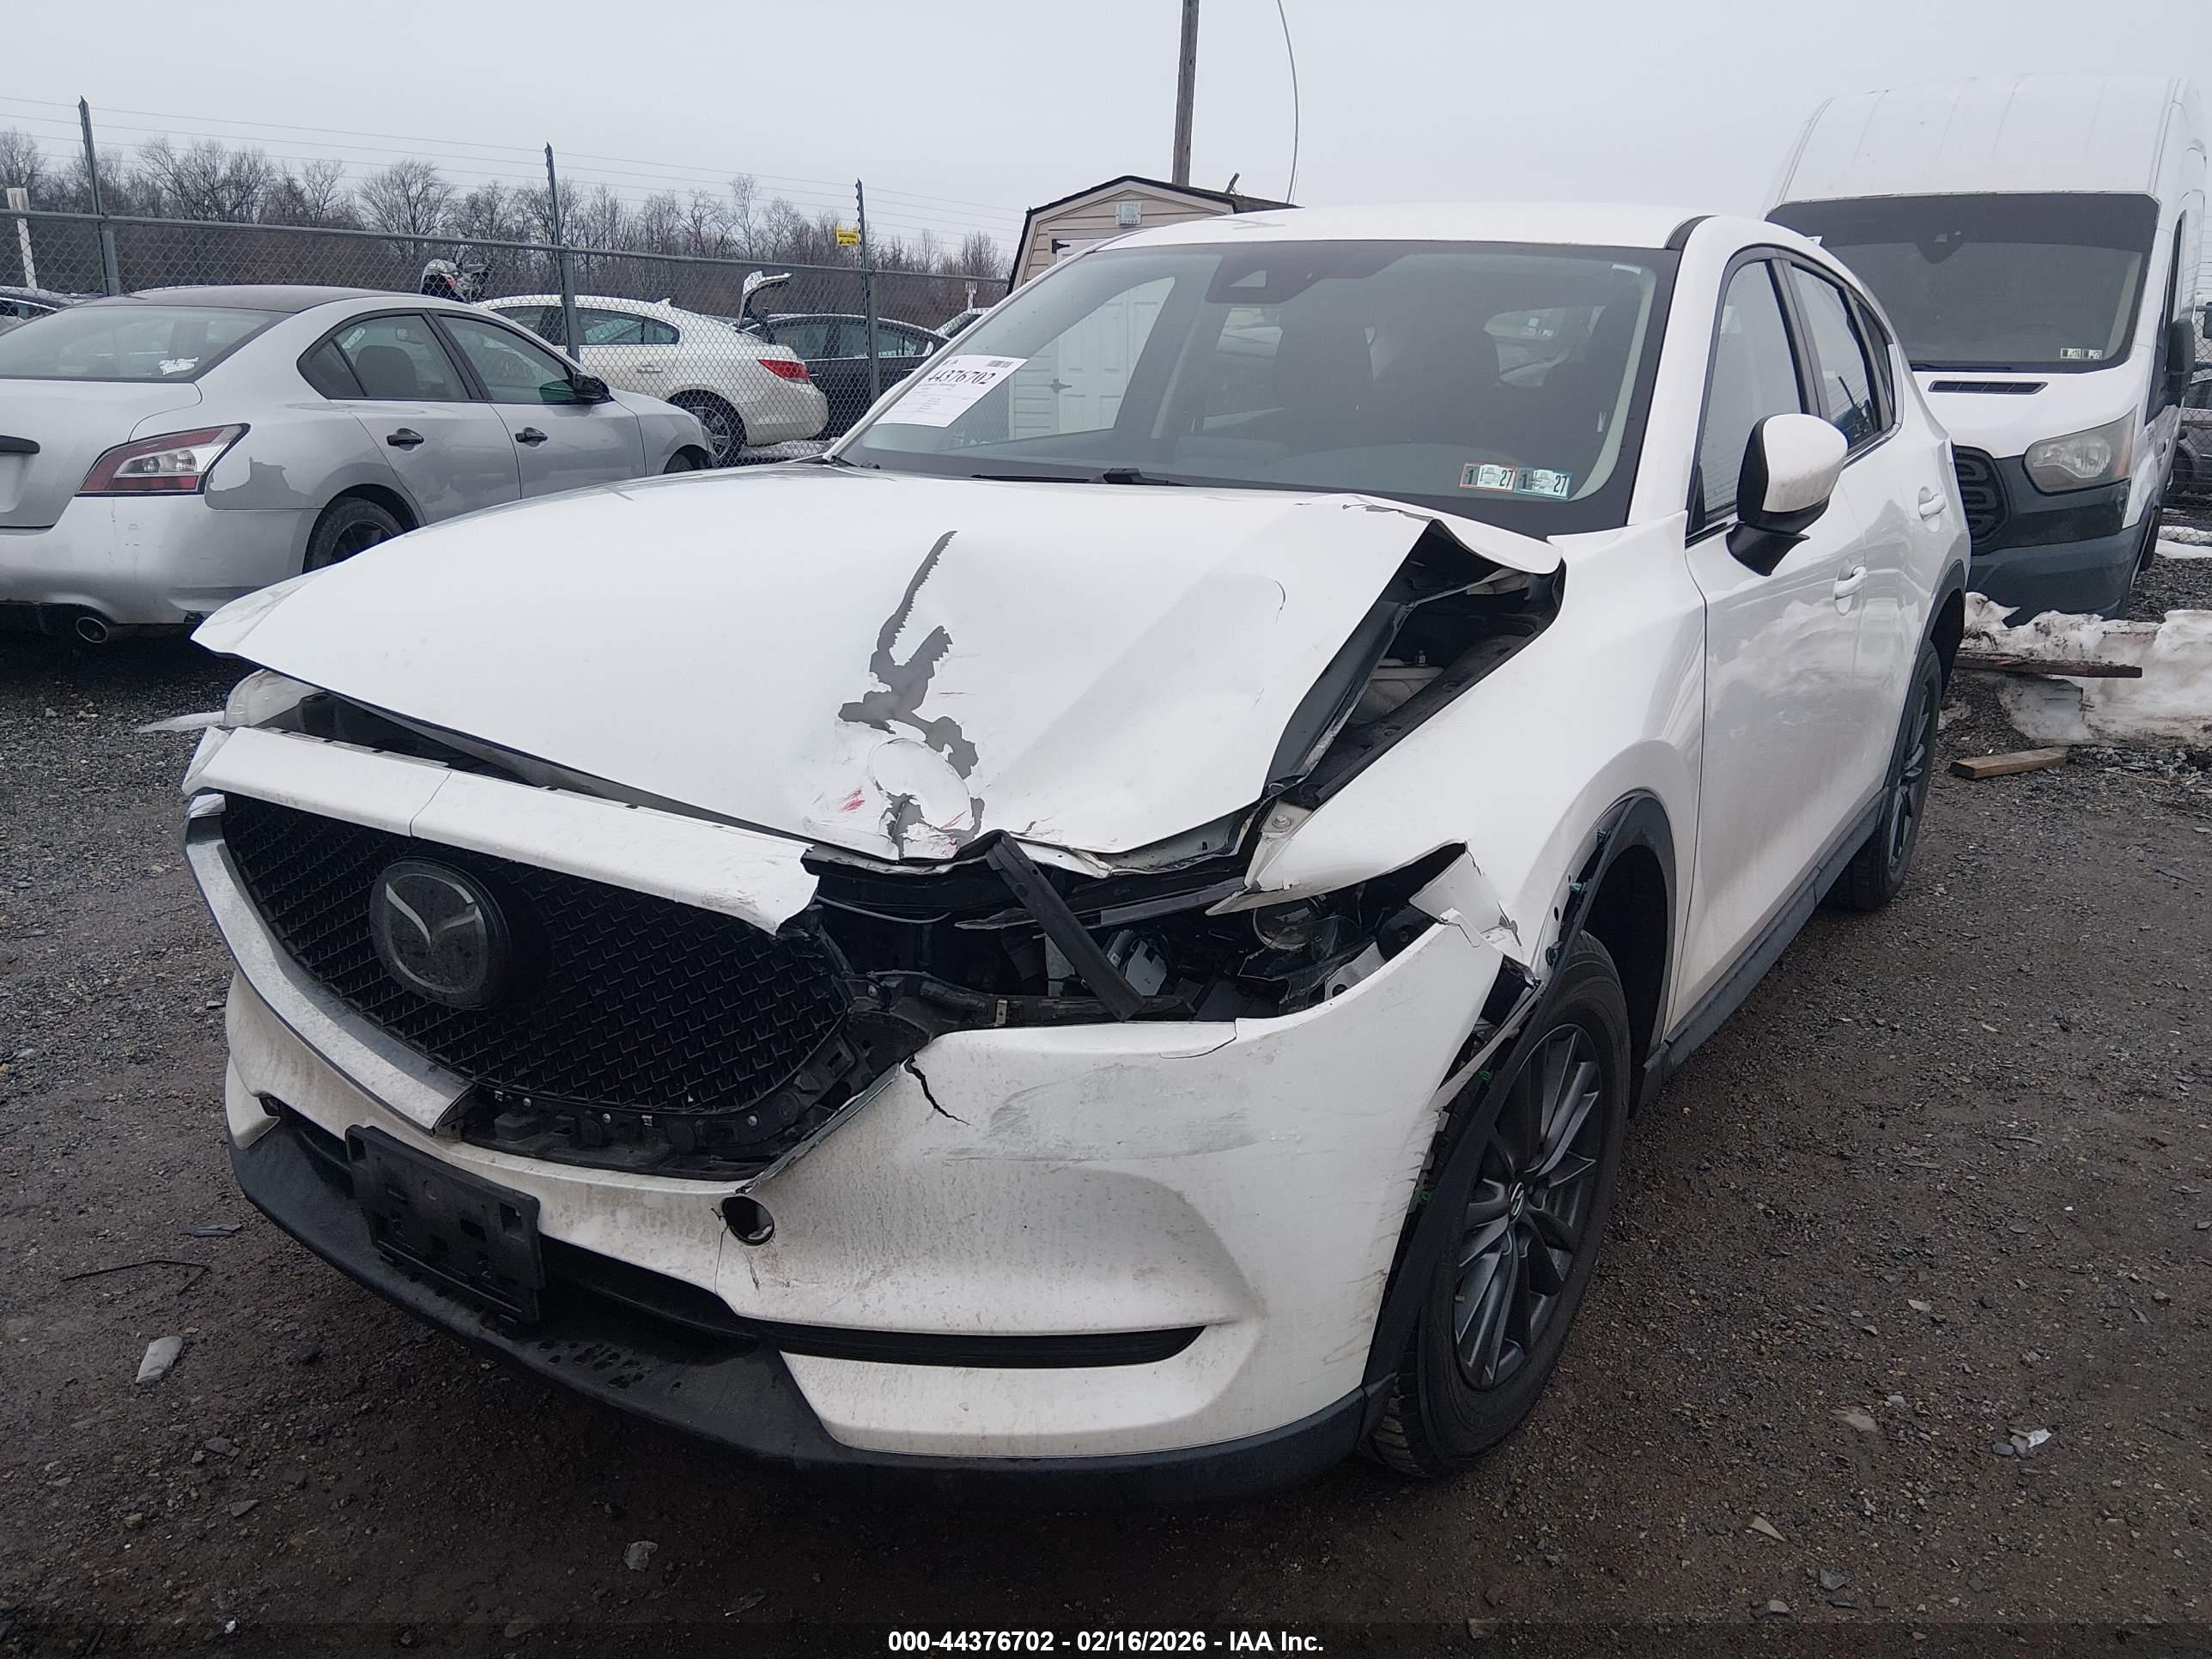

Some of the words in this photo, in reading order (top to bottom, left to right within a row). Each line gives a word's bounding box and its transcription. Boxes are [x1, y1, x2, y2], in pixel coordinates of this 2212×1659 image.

[927, 369, 997, 386] 44376702
[1467, 469, 1475, 485] 1
[1499, 469, 1514, 489] 27
[1521, 473, 1528, 489] 1
[1553, 474, 1568, 495] 27
